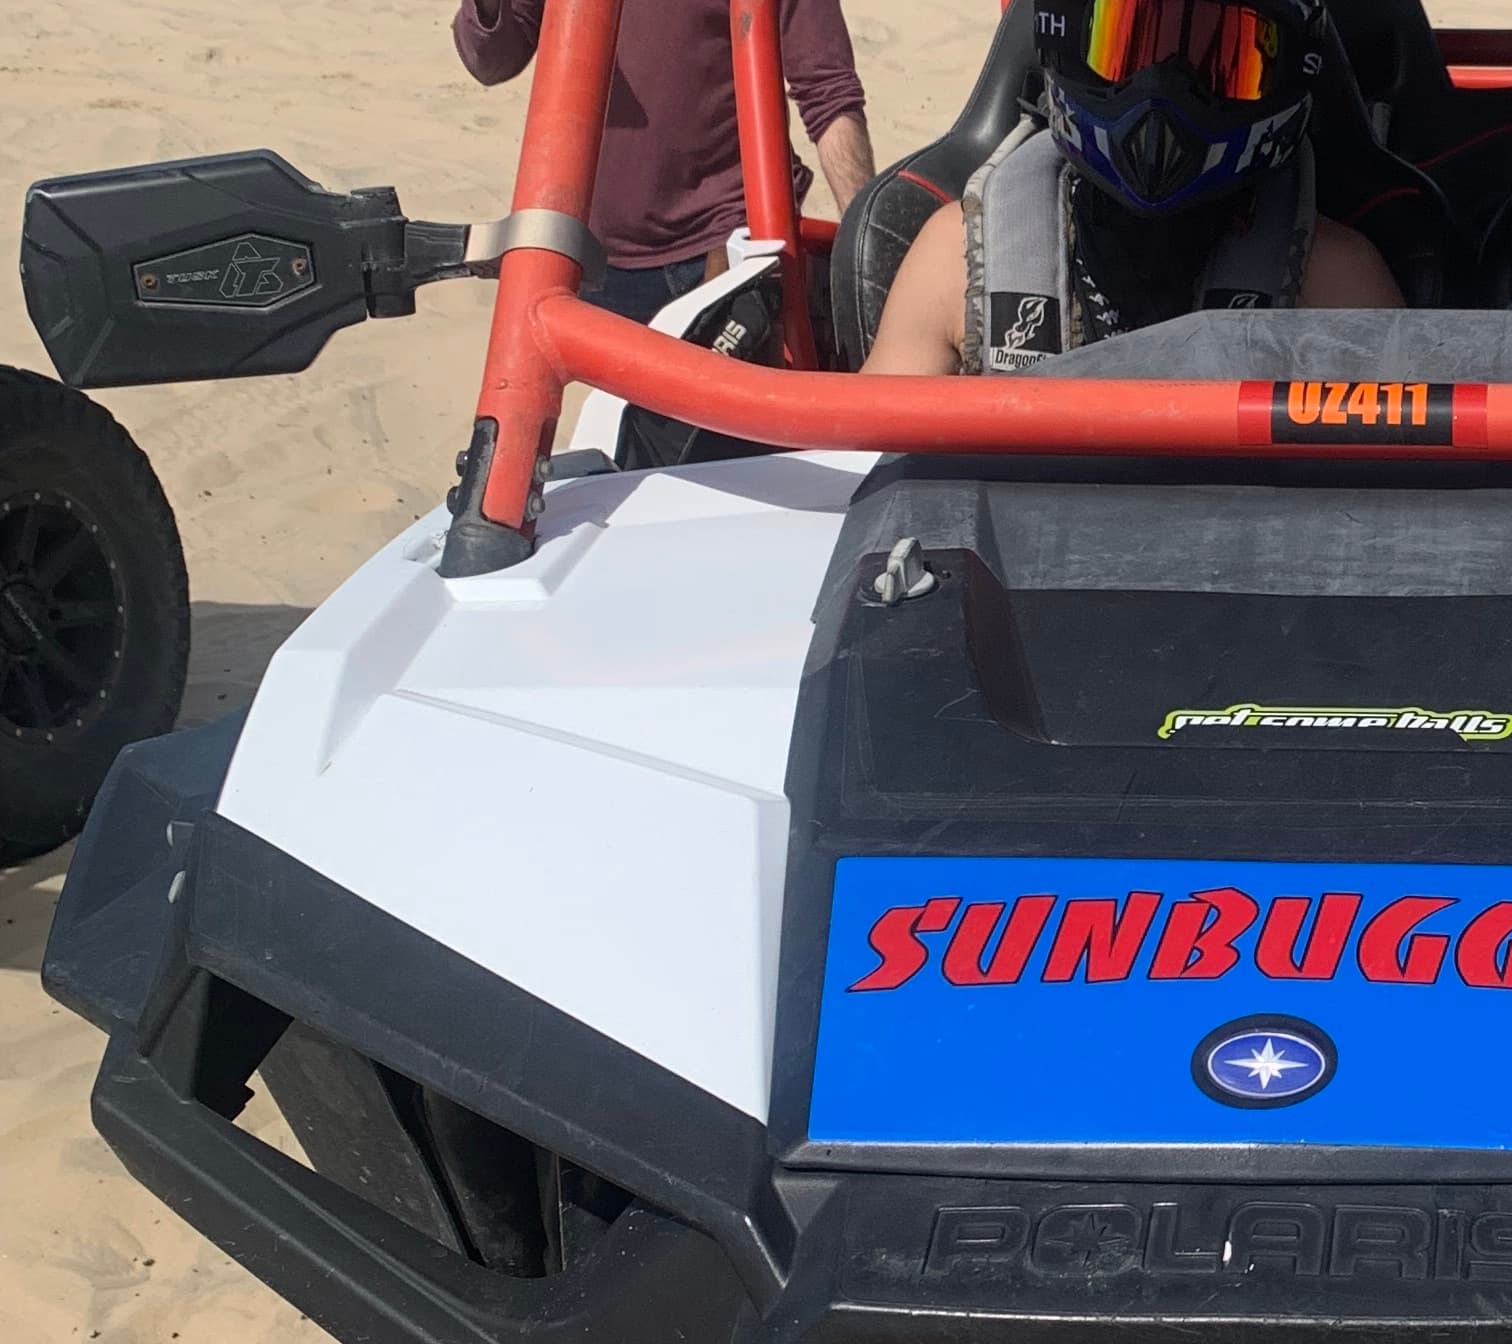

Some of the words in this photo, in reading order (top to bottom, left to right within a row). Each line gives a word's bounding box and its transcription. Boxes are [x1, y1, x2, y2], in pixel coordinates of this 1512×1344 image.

[1034, 10, 1067, 38] TH
[166, 269, 220, 284] TUSK
[1287, 381, 1429, 425] UZ411
